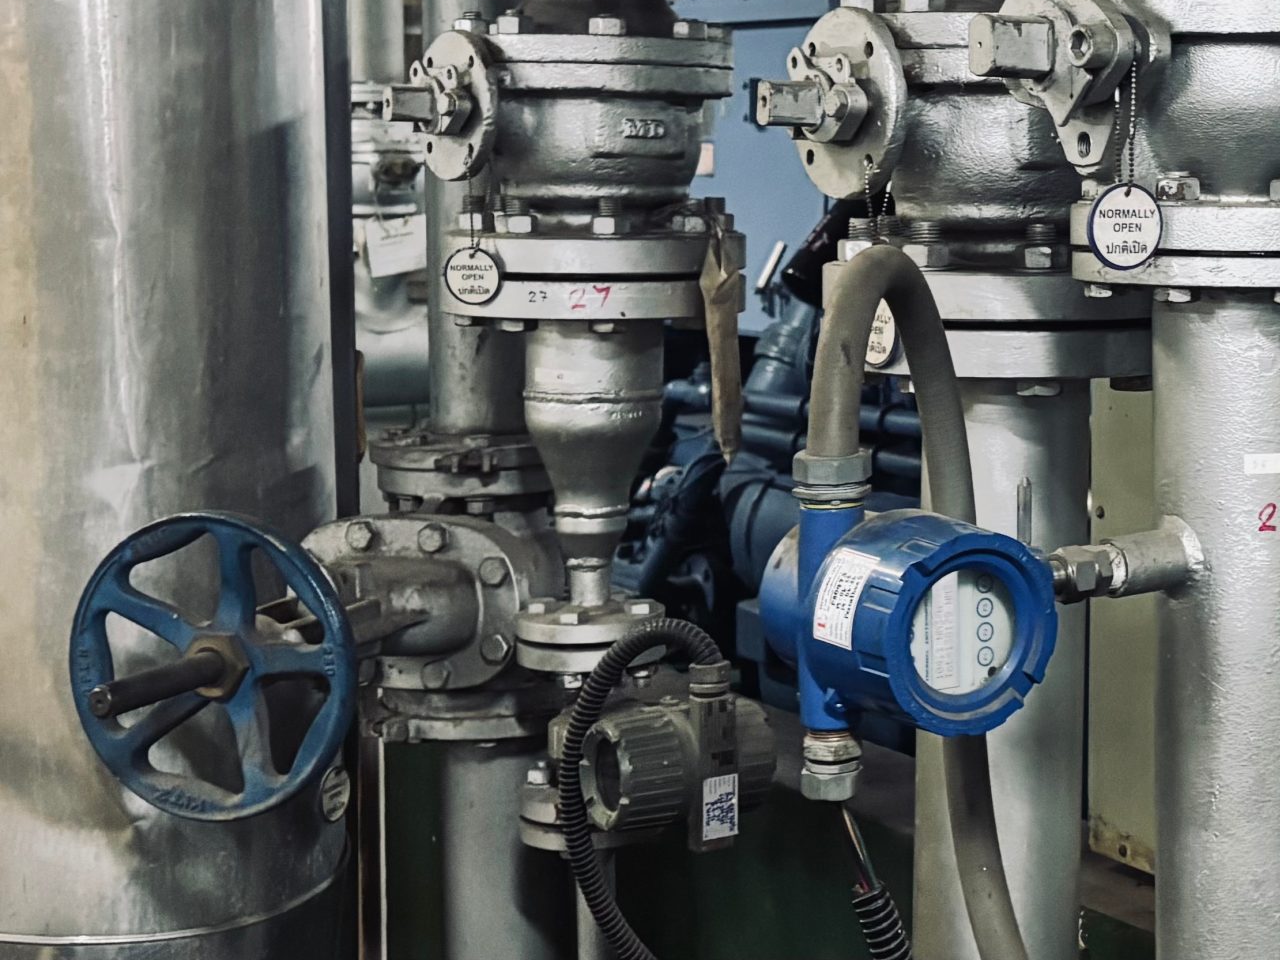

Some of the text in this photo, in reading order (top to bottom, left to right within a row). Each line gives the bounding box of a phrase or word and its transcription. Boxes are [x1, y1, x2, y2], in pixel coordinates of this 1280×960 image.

[1098, 208, 1156, 219] NORMALLY
[1113, 222, 1142, 233] OPEN
[1106, 240, 1148, 254] ปกติเปิด
[450, 264, 494, 272] NORMALLY
[461, 273, 484, 281] OPEN
[528, 290, 547, 303] 27
[568, 284, 611, 310] 27
